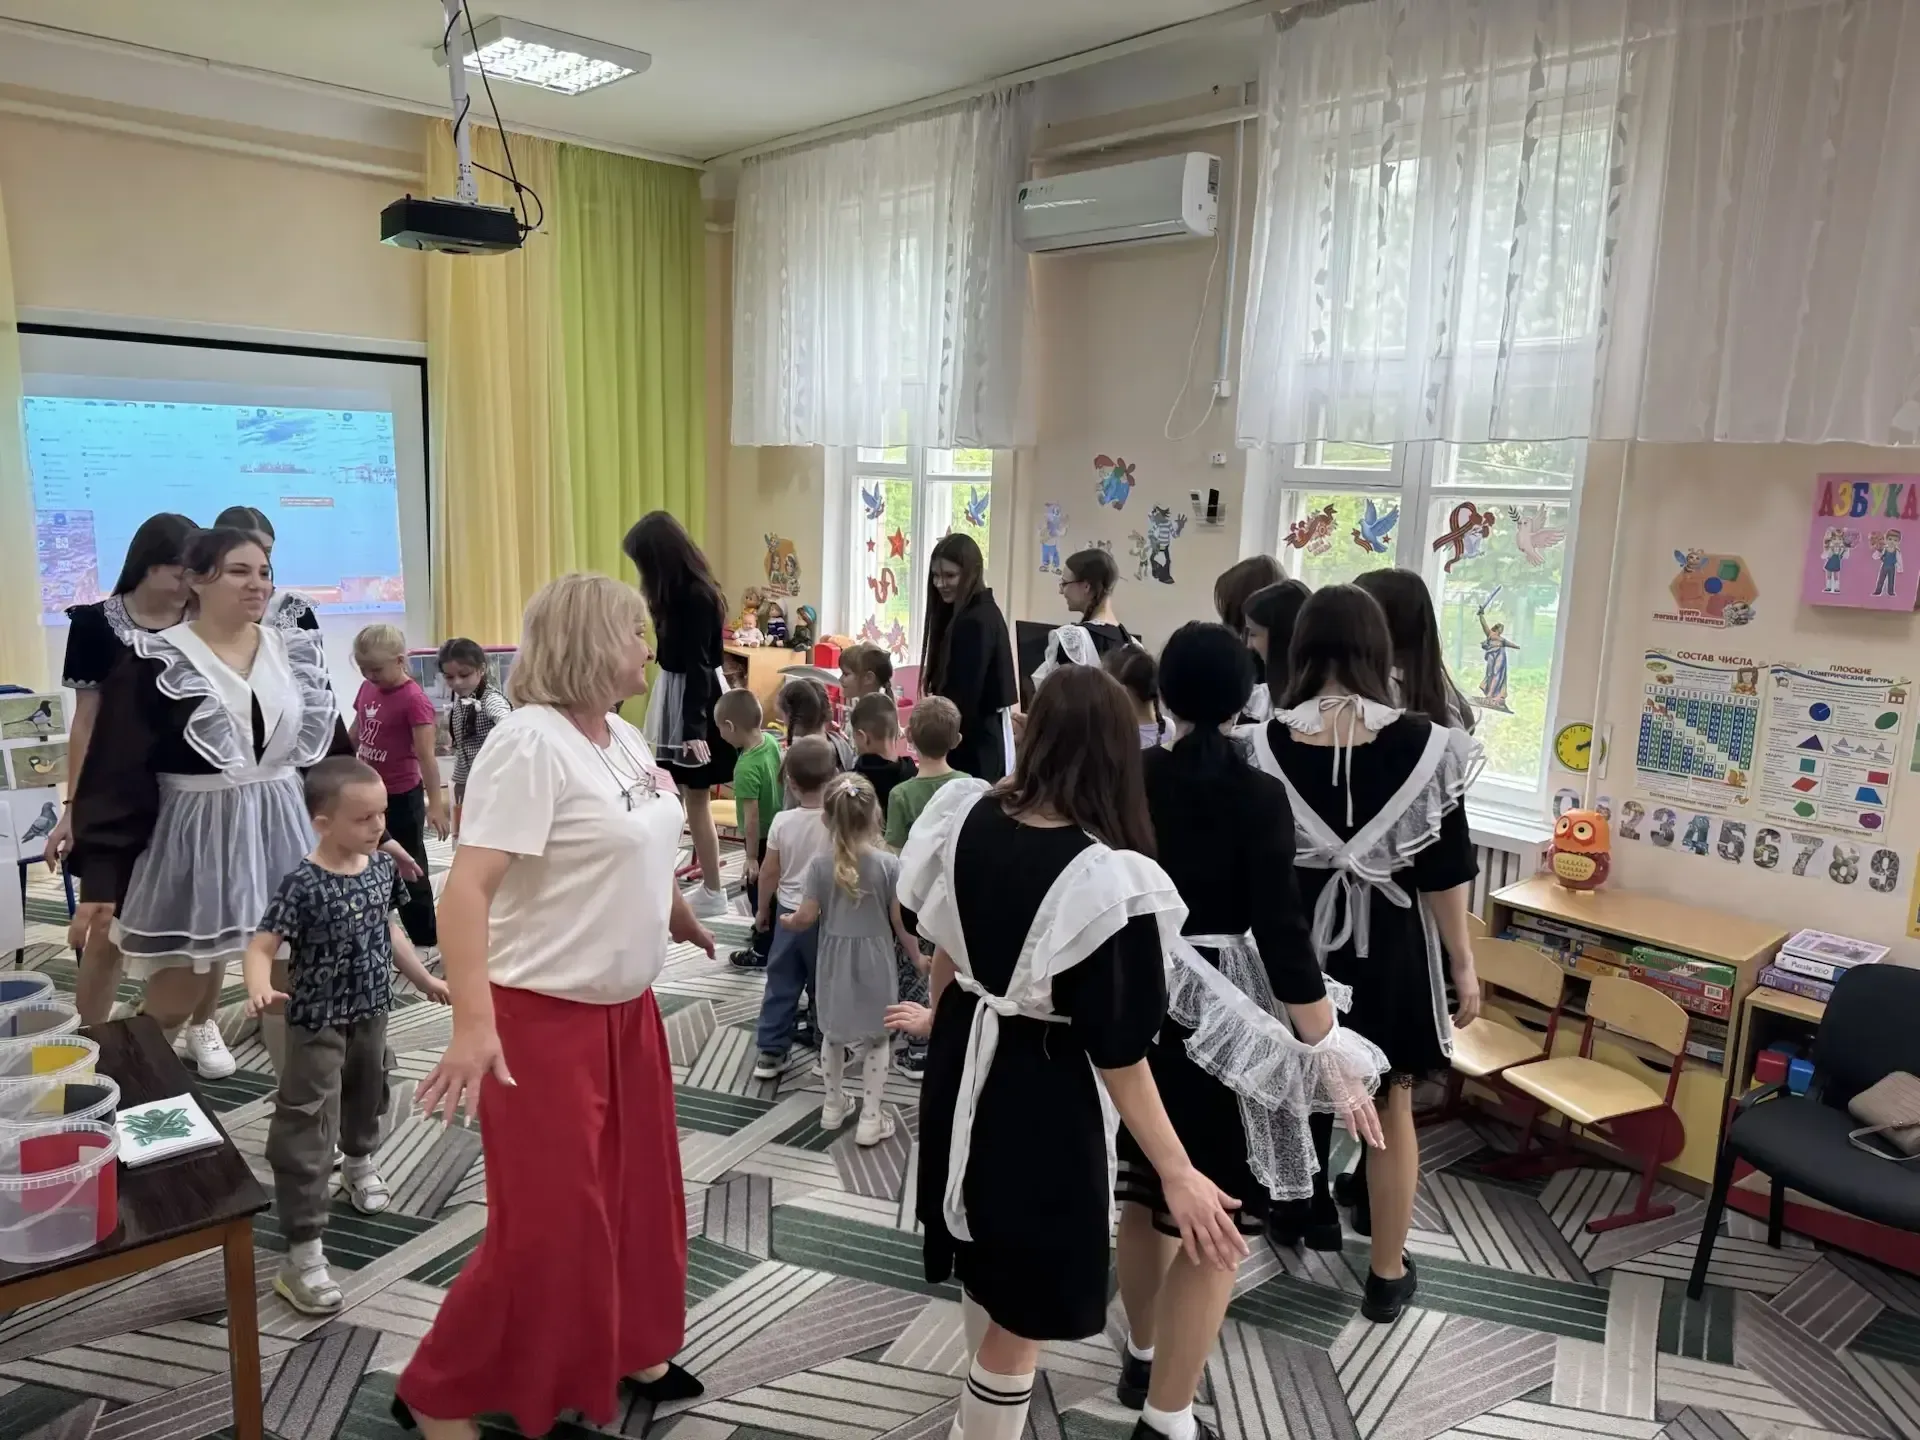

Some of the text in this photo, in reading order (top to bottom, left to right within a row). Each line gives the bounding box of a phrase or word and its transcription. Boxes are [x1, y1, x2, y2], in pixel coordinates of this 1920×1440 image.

[1818, 480, 1919, 520] АЗБУКА
[1677, 651, 1753, 666] СОСТАВ ЧИСЛА
[1807, 669, 1894, 684] ГЕОМЕТРИЧЕСКИЕ ФИГУРЫ
[1829, 664, 1872, 675] ПЛОСКИЕ
[1619, 800, 1645, 840] 2
[1650, 808, 1676, 847] 3
[1682, 815, 1710, 856] 4
[1717, 820, 1747, 864] 5
[1753, 828, 1781, 868] 6
[1791, 832, 1824, 876] 7
[1829, 841, 1860, 884] 8
[1868, 849, 1900, 893] 9
[1791, 961, 1812, 972] Puzzle
